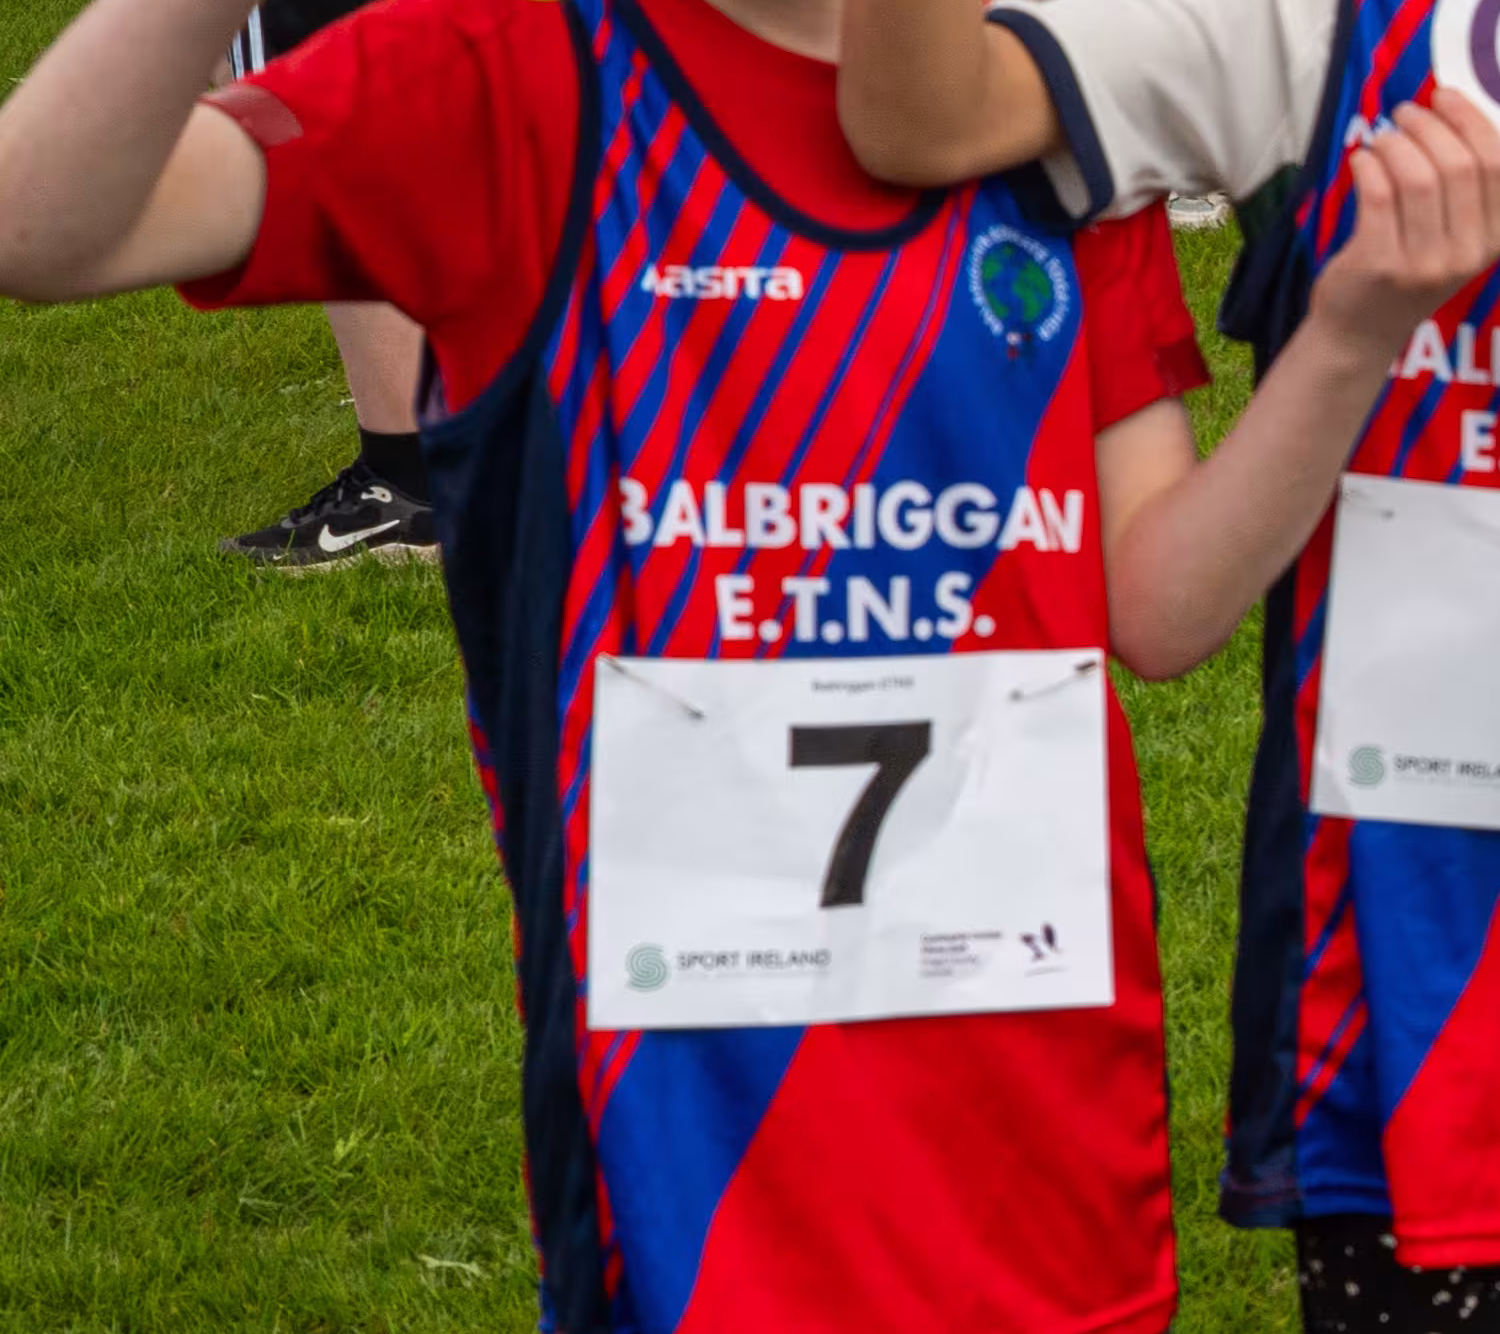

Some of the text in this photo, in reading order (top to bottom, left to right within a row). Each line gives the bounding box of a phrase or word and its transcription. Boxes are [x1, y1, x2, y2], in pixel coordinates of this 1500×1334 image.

[619, 478, 1085, 553] BALBRIGGAN
[714, 571, 996, 643] E.T.N.S.
[789, 720, 932, 910] 7
[677, 948, 832, 971] SPORT IRELAND
